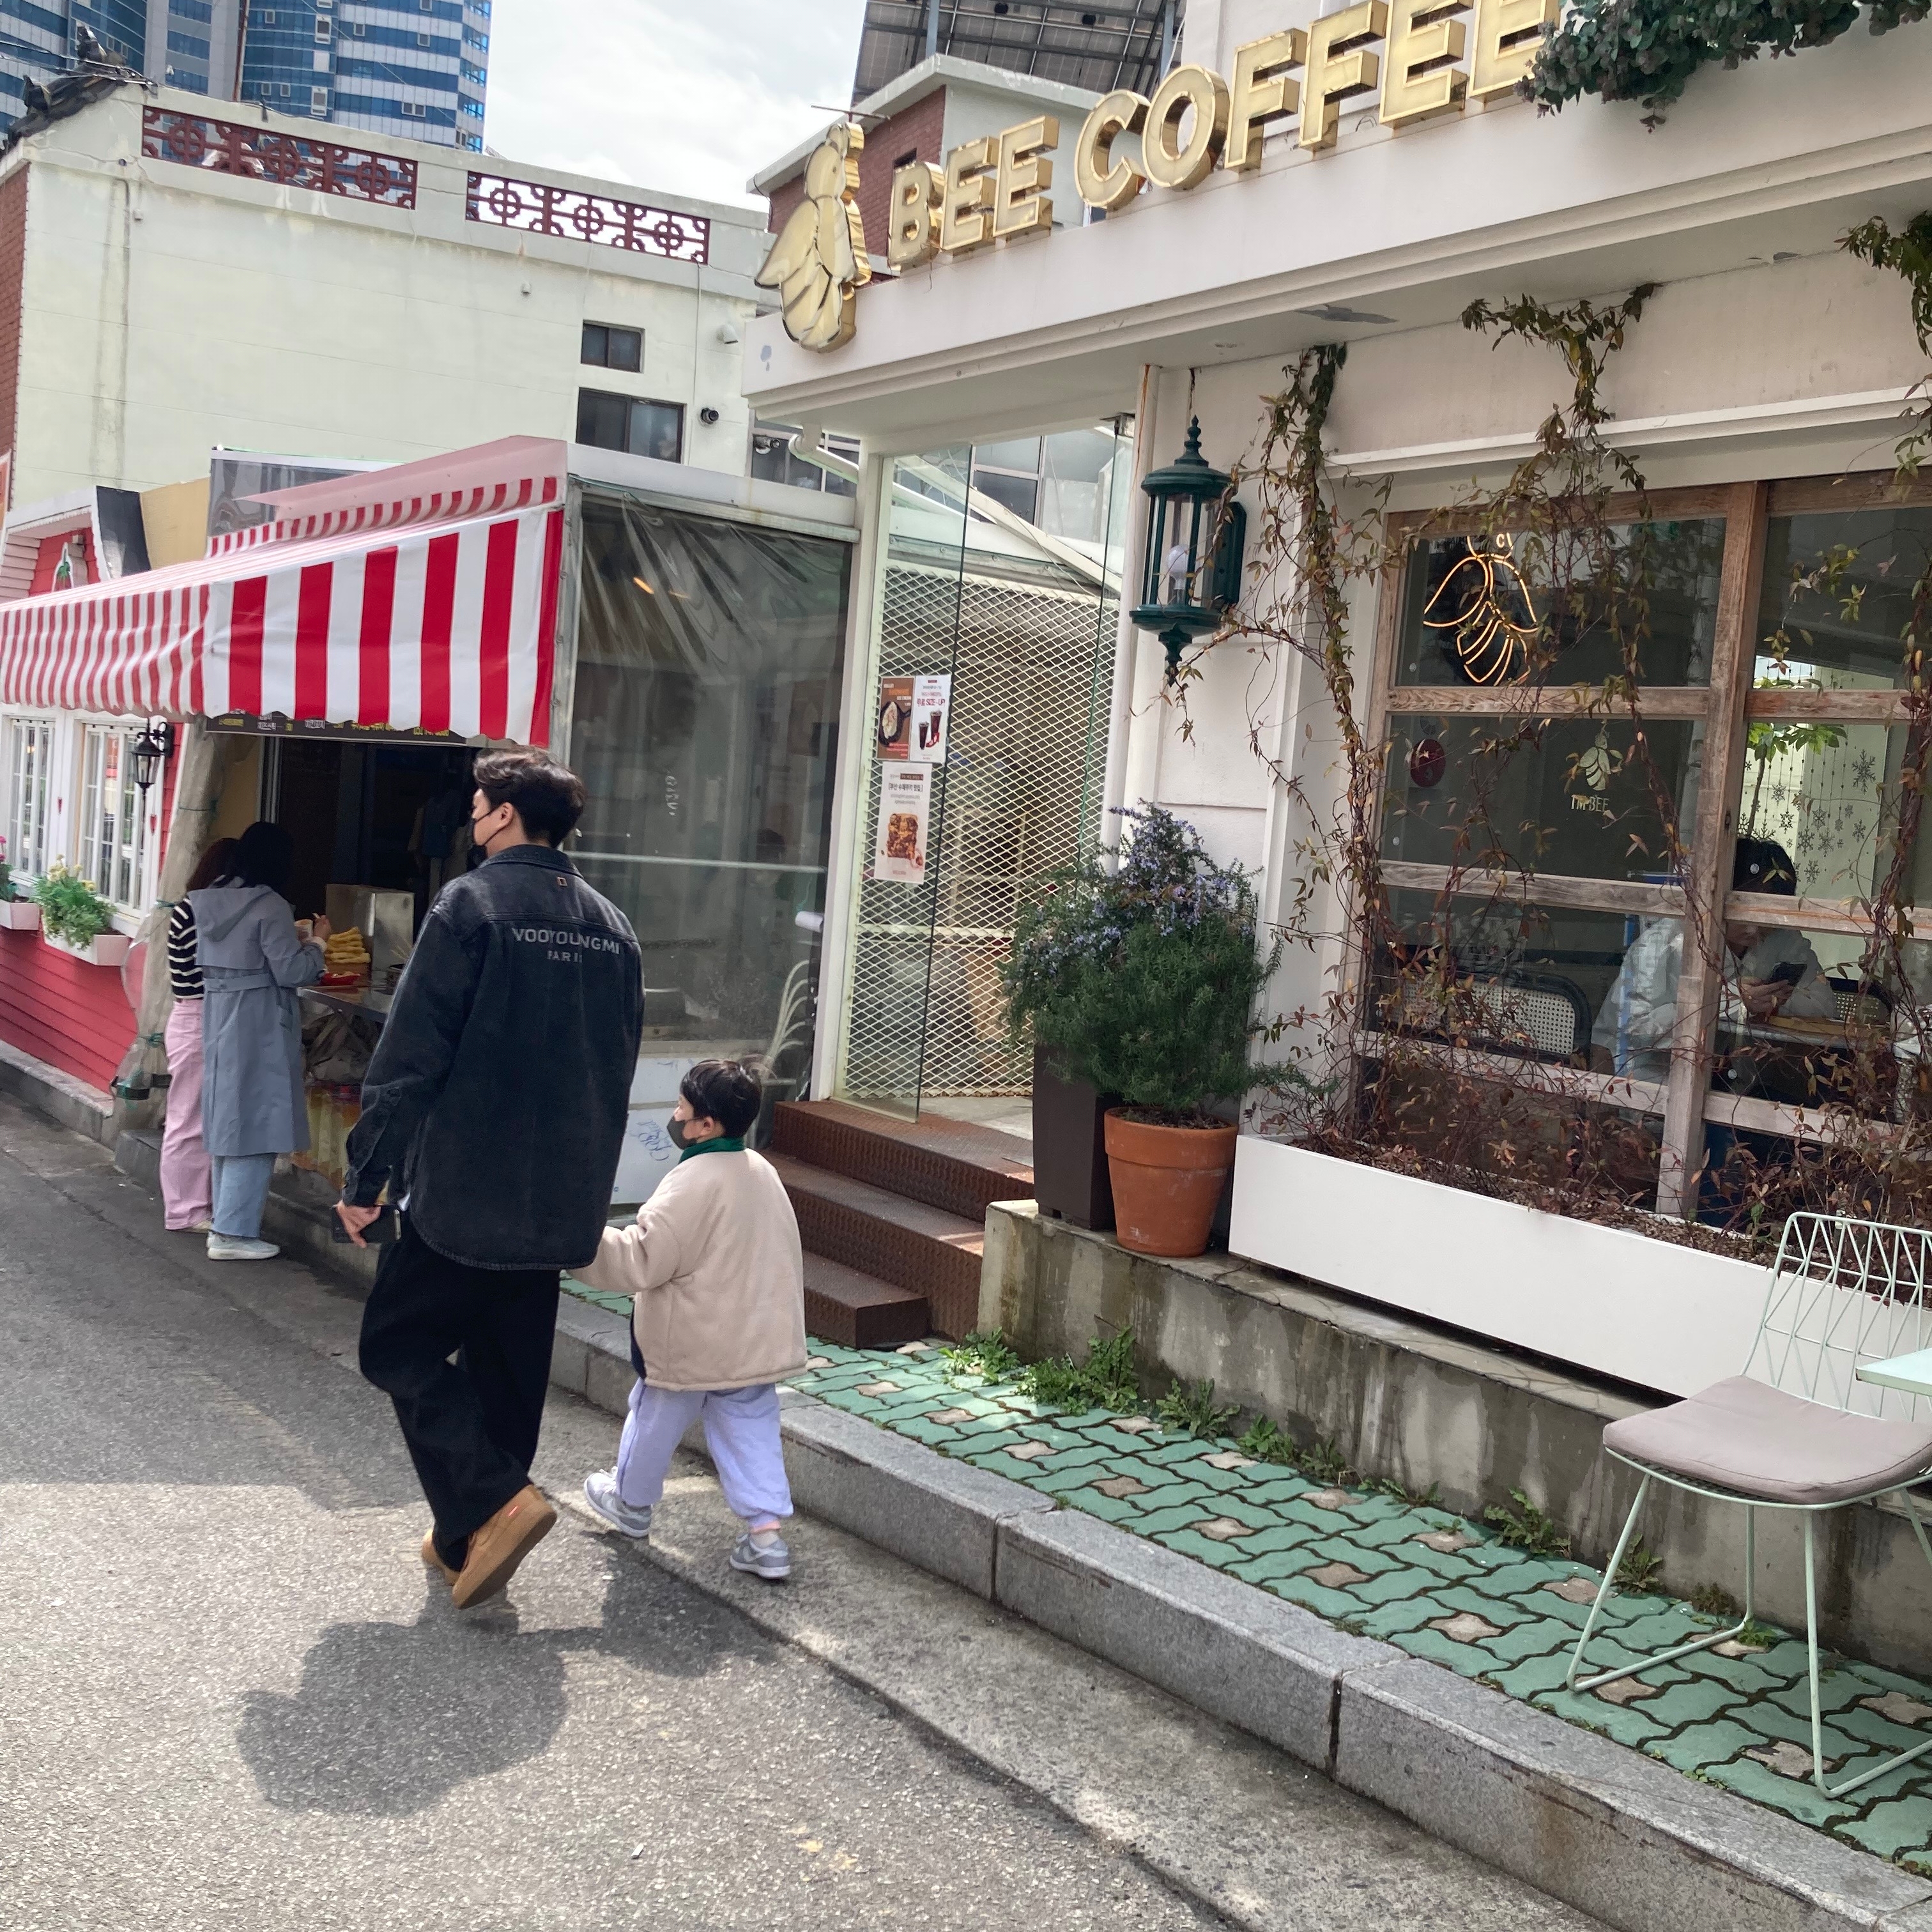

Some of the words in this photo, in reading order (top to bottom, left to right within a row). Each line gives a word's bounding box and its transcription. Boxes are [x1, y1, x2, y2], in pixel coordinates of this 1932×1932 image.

[887, 115, 1059, 270] BEE
[1074, 0, 1560, 210] COFFEE
[1588, 795, 1610, 812] BEE
